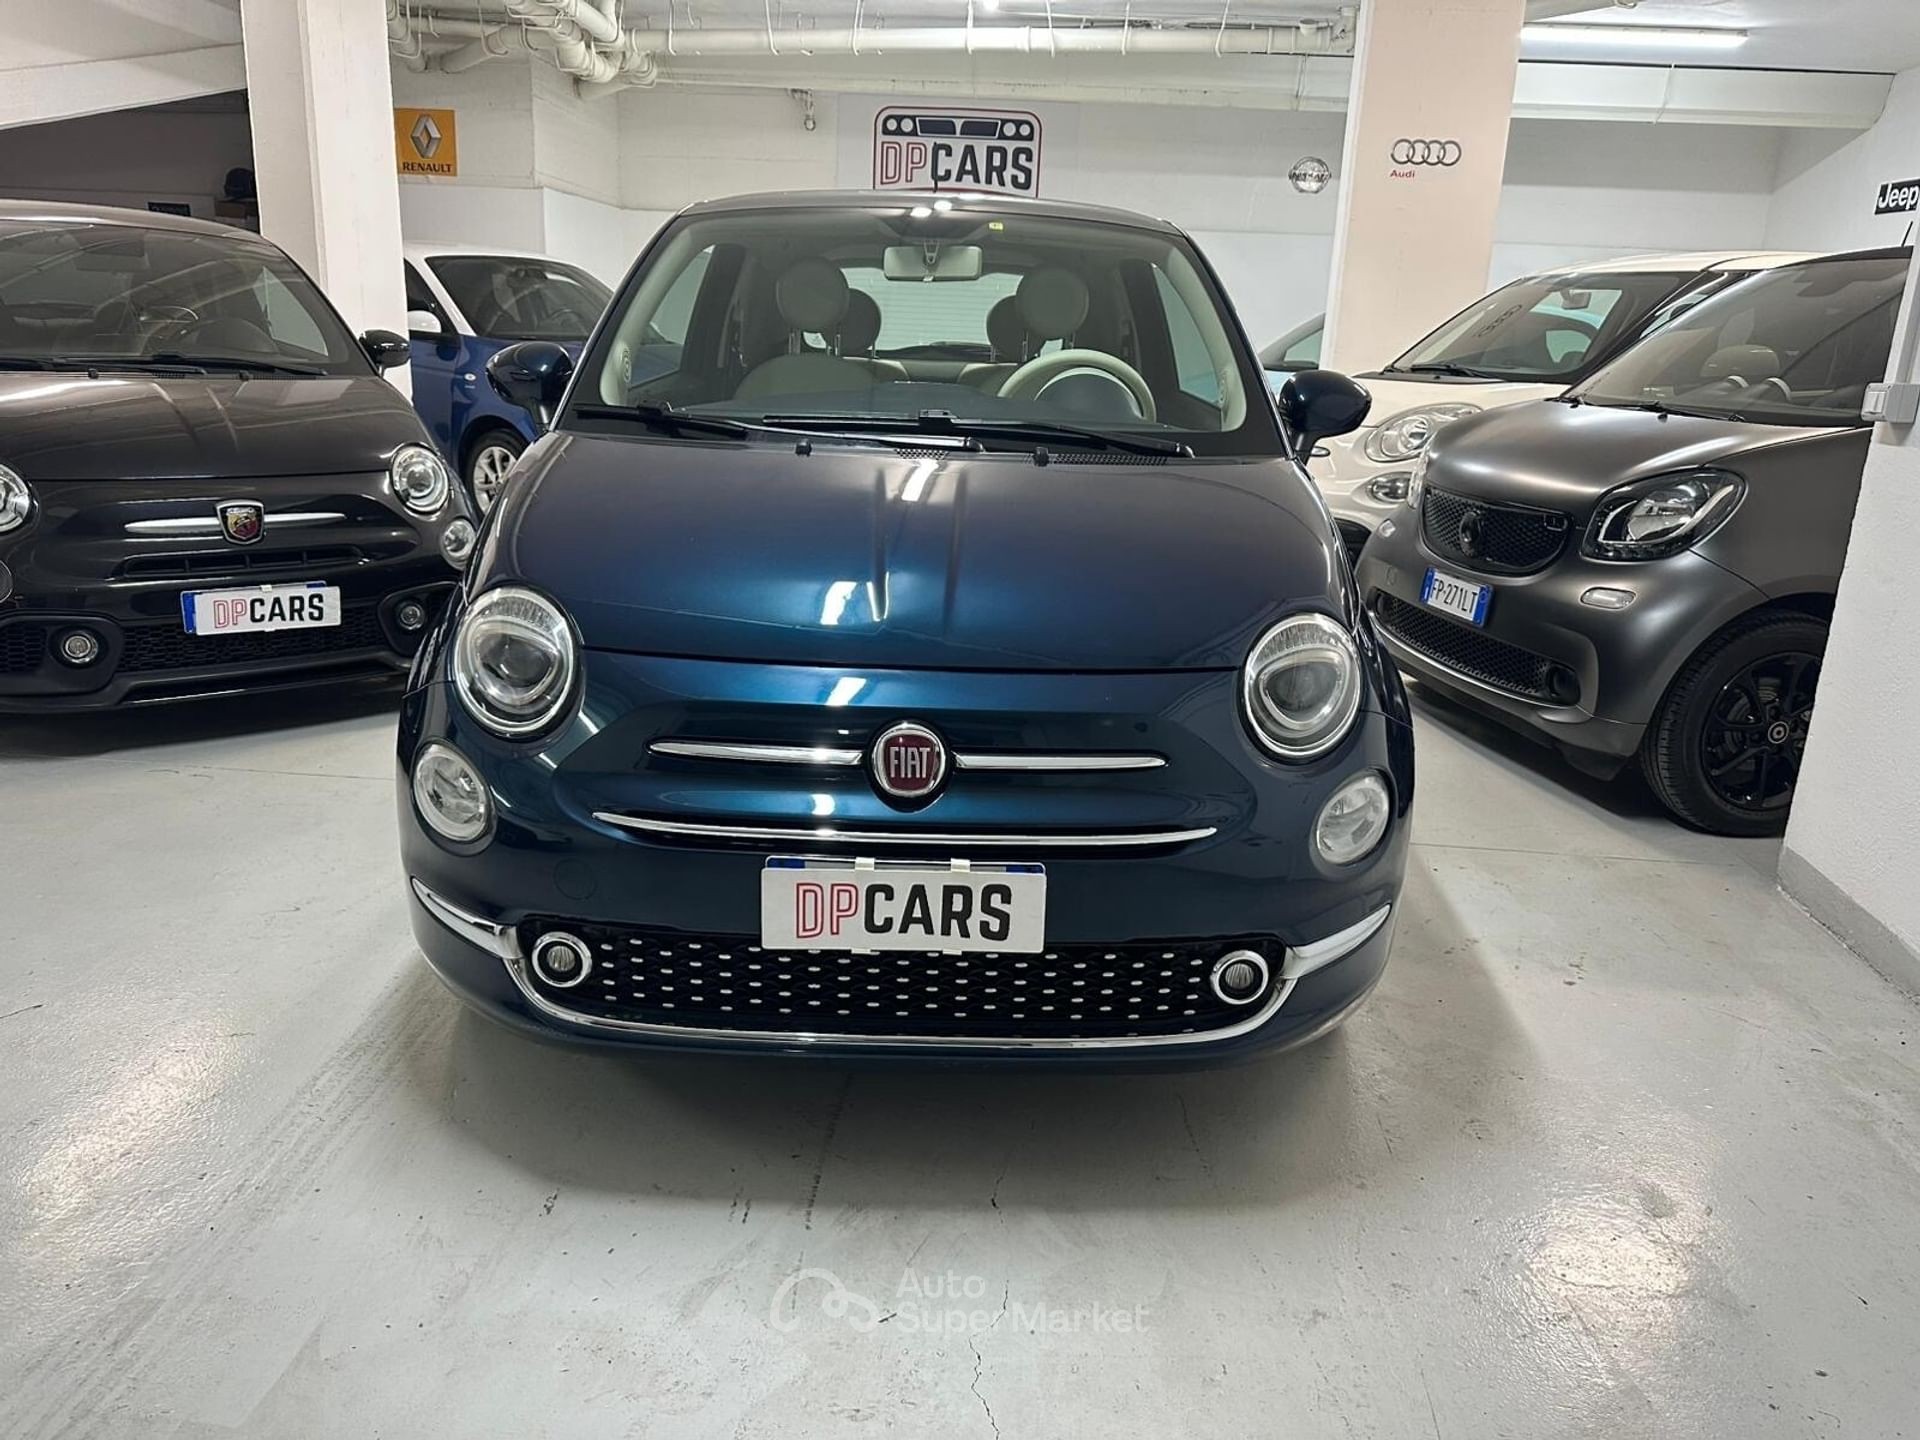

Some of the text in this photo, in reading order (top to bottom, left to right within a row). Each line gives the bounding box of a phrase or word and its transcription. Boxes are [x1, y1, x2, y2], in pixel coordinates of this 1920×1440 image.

[402, 161, 452, 173] RENAULT
[880, 141, 1033, 190] DPCARS
[1390, 169, 1415, 178] Audi
[1878, 183, 1920, 210] Jeep
[213, 593, 324, 629] DPCARS
[889, 746, 931, 778] FIAT
[796, 883, 1012, 942] DPCARS
